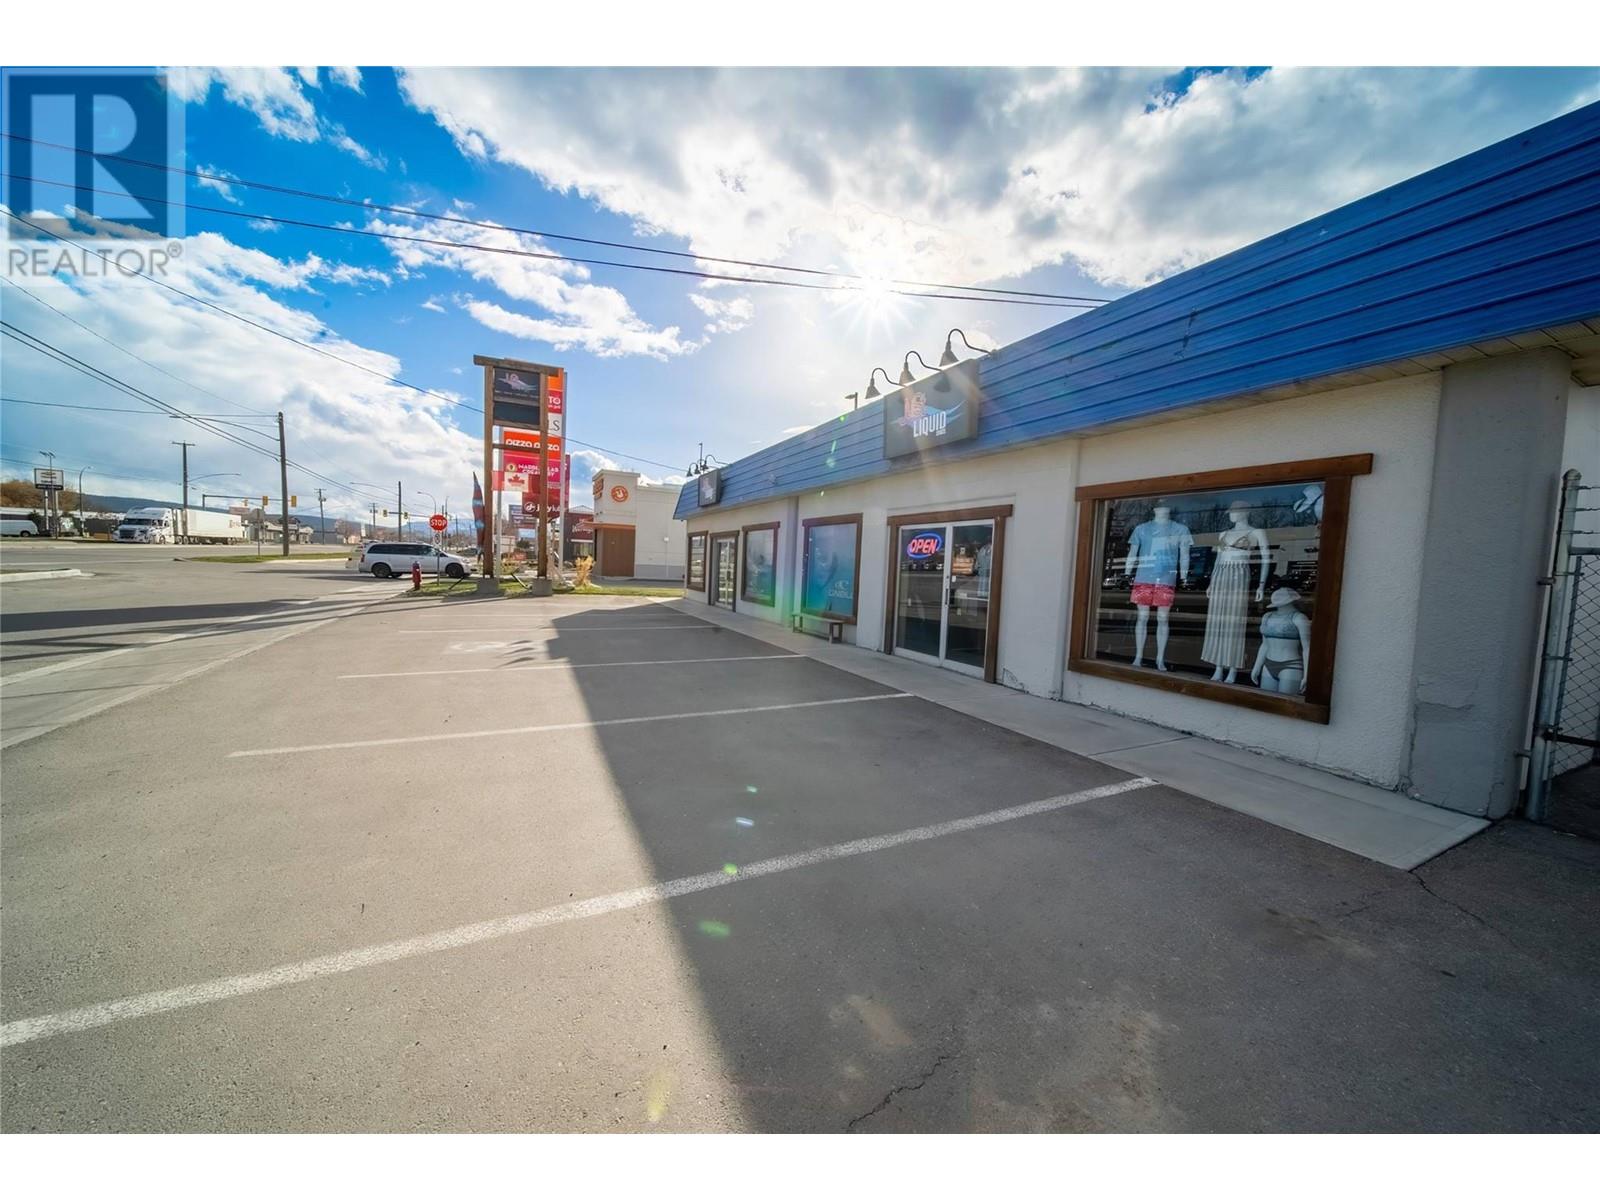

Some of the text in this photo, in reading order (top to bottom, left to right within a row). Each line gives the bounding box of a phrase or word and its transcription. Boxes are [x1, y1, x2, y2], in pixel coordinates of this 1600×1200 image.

[913, 411, 946, 438] LIQUID
[431, 519, 447, 527] STOP
[911, 538, 938, 554] OPEN
